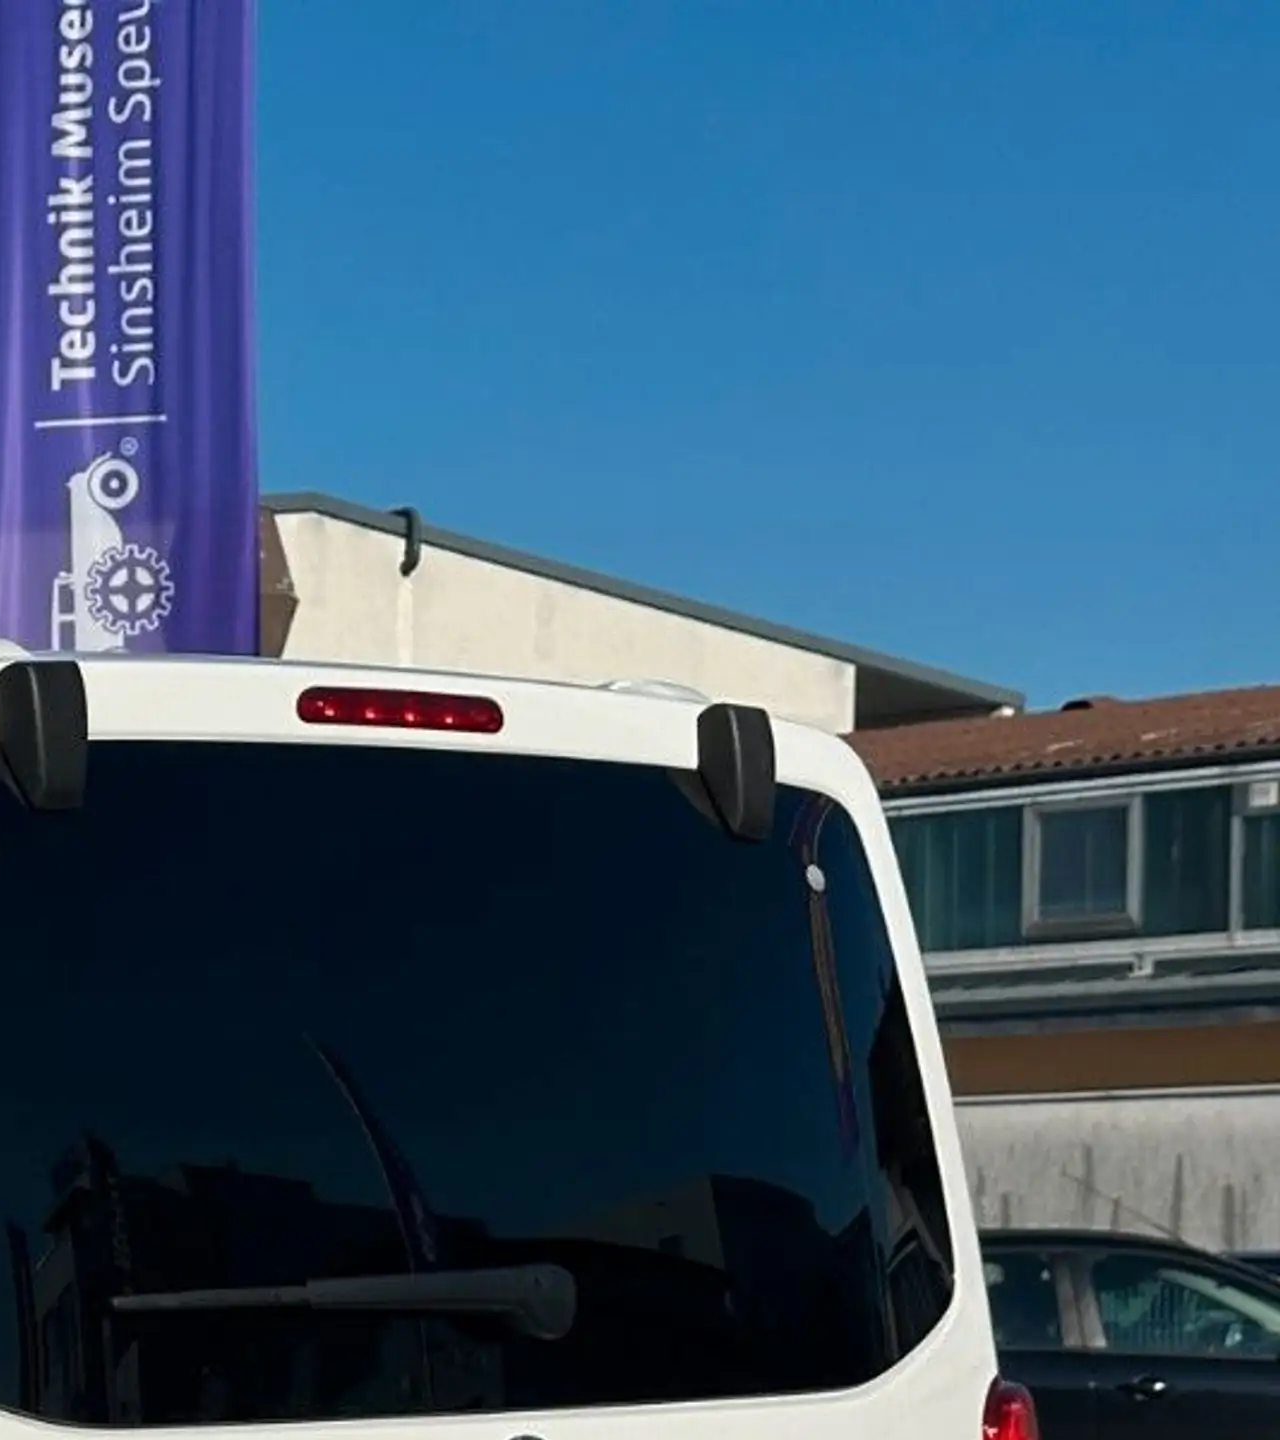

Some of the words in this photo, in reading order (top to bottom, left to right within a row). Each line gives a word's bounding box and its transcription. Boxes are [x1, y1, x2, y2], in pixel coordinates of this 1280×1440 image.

[50, 0, 94, 158] Muse
[47, 174, 96, 391] Technik
[107, 139, 156, 387] Sinsheim
